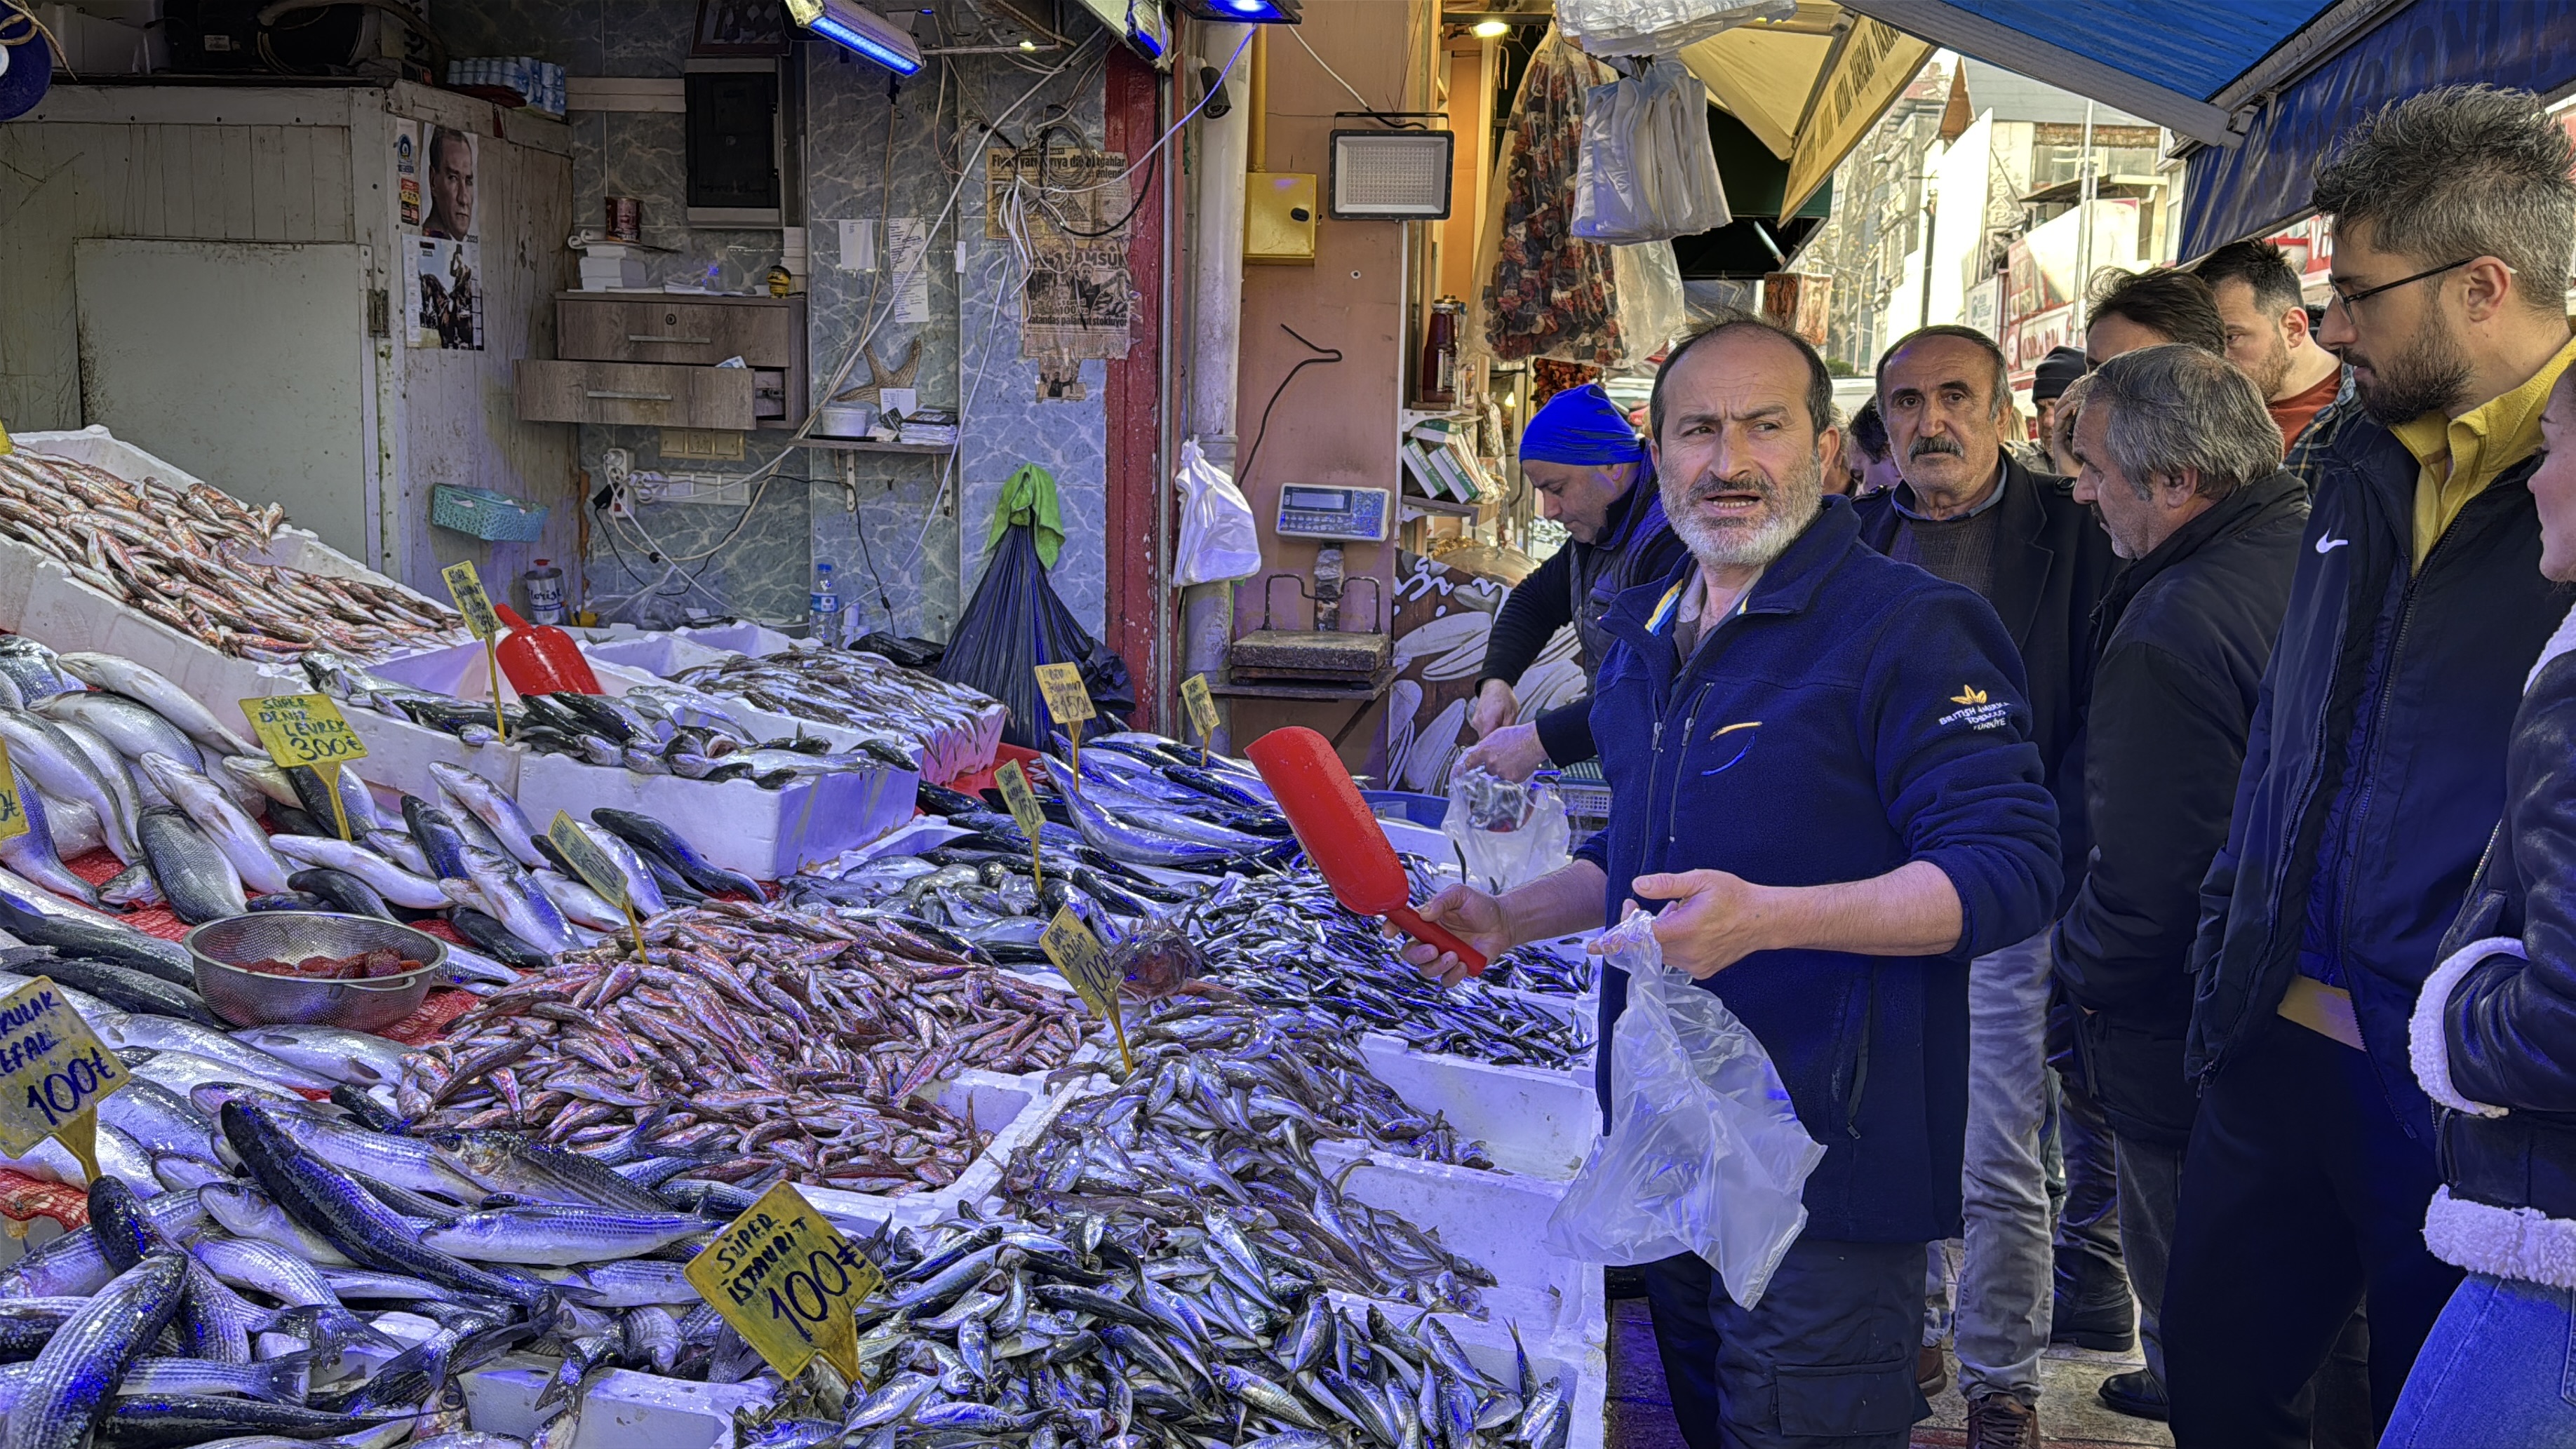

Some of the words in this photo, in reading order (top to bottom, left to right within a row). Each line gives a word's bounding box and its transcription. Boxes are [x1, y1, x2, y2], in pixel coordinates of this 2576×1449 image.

[261, 696, 311, 710] SÜPER
[258, 710, 310, 723] DENİZ
[1938, 707, 1976, 725] BRITISH
[283, 719, 354, 737] LEVREK
[716, 1213, 780, 1275] SÜPER
